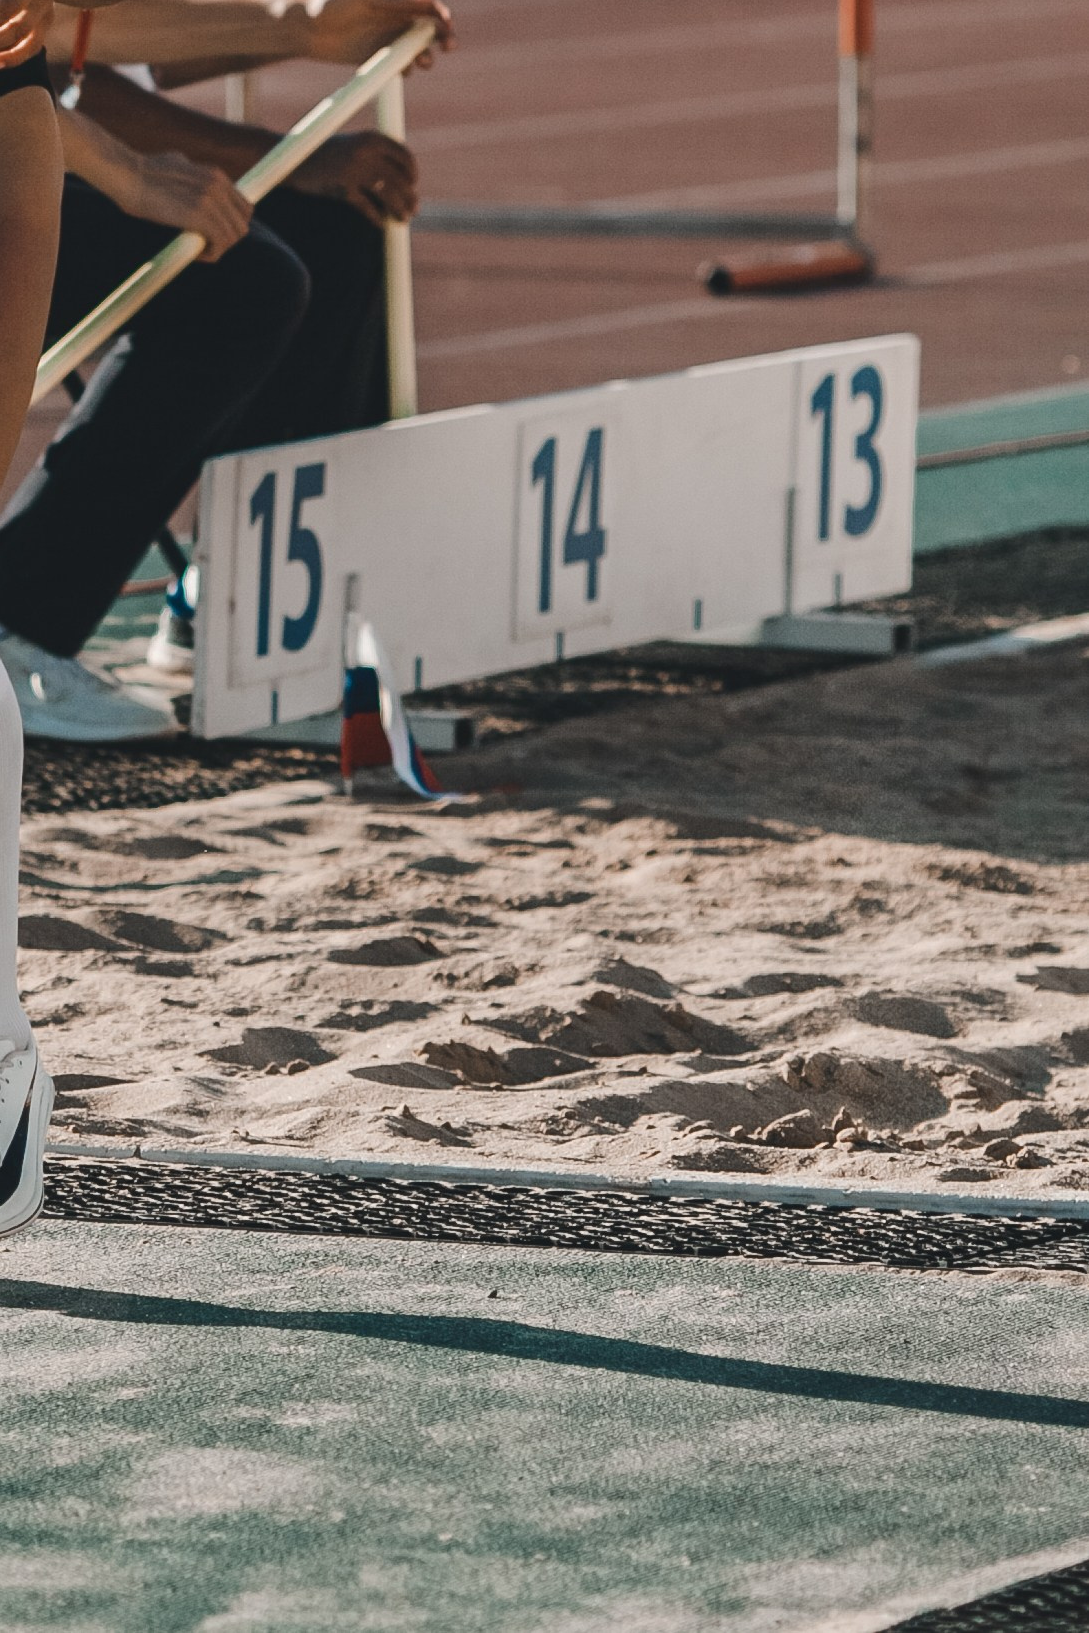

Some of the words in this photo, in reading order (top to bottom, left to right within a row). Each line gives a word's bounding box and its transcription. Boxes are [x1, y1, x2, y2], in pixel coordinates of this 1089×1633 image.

[532, 427, 606, 614] 14
[810, 365, 883, 543] 13
[249, 462, 326, 658] 15
